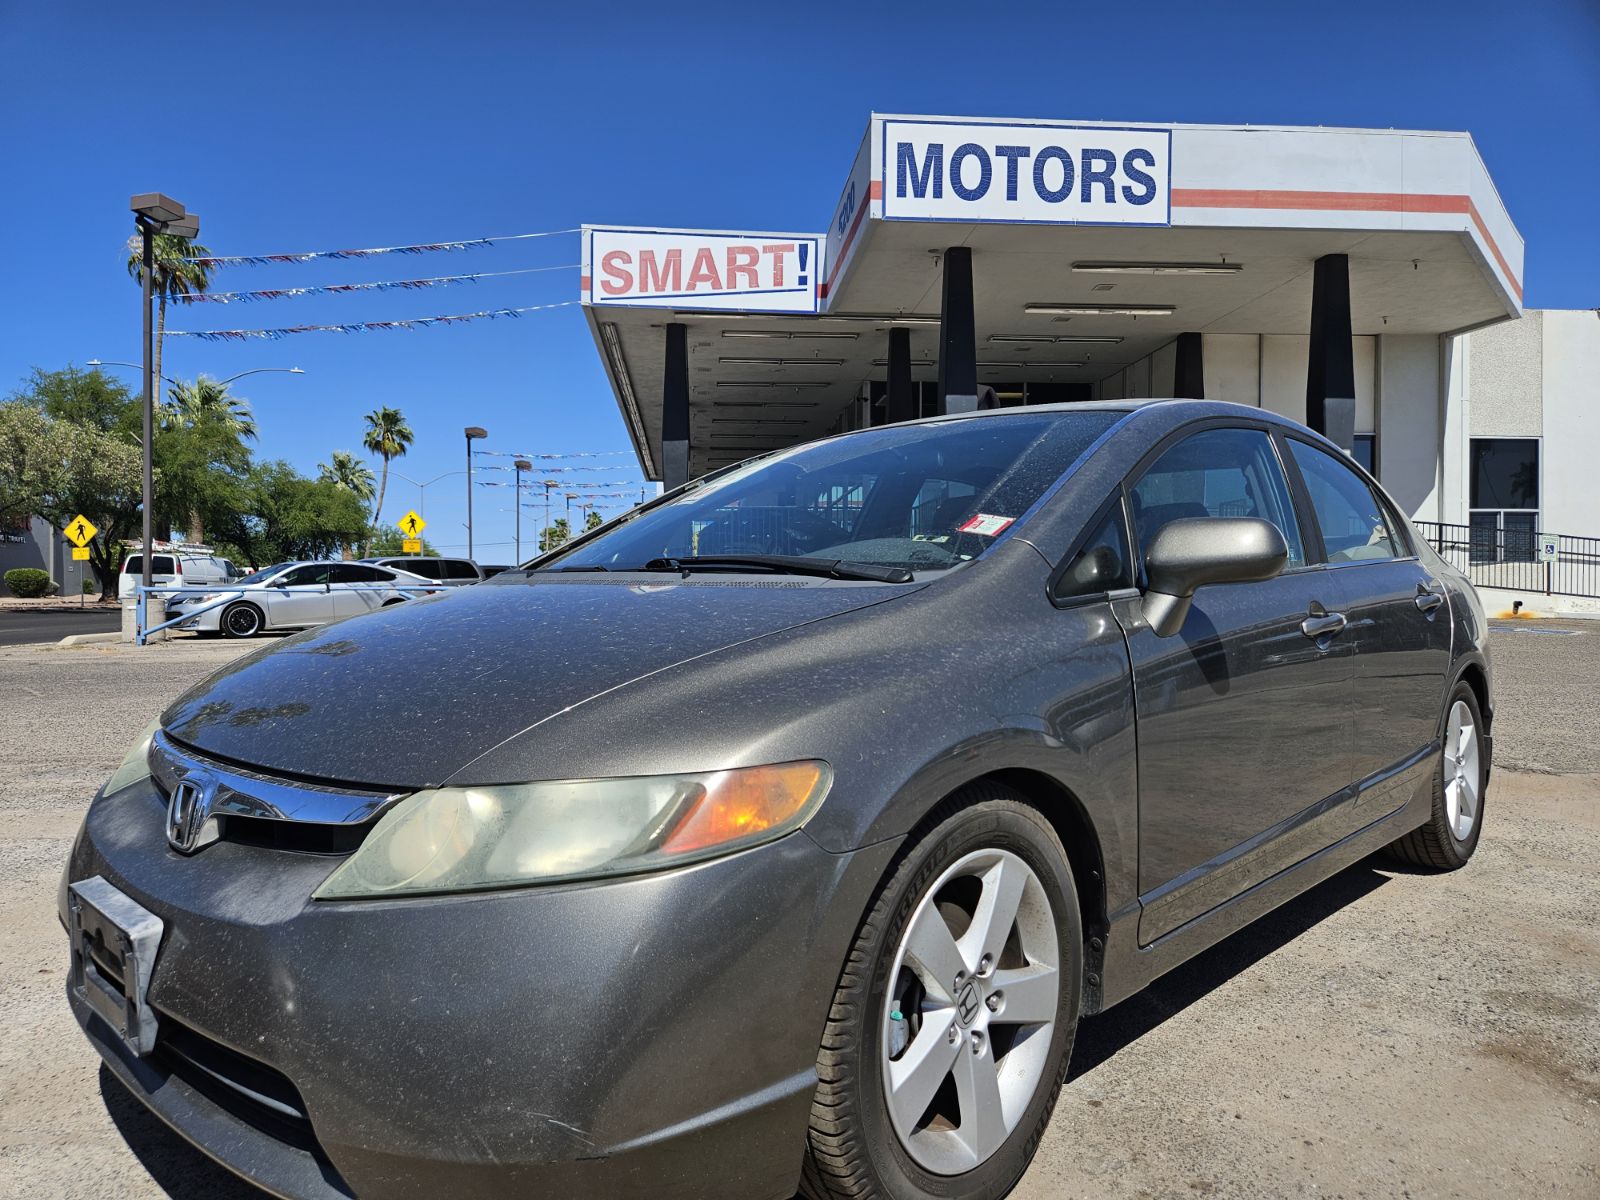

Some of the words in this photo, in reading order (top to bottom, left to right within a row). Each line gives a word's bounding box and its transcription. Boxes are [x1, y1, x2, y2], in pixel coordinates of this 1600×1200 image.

[896, 142, 1157, 206] MOTORS
[838, 181, 855, 233] 5200
[600, 243, 809, 295] SMART!
